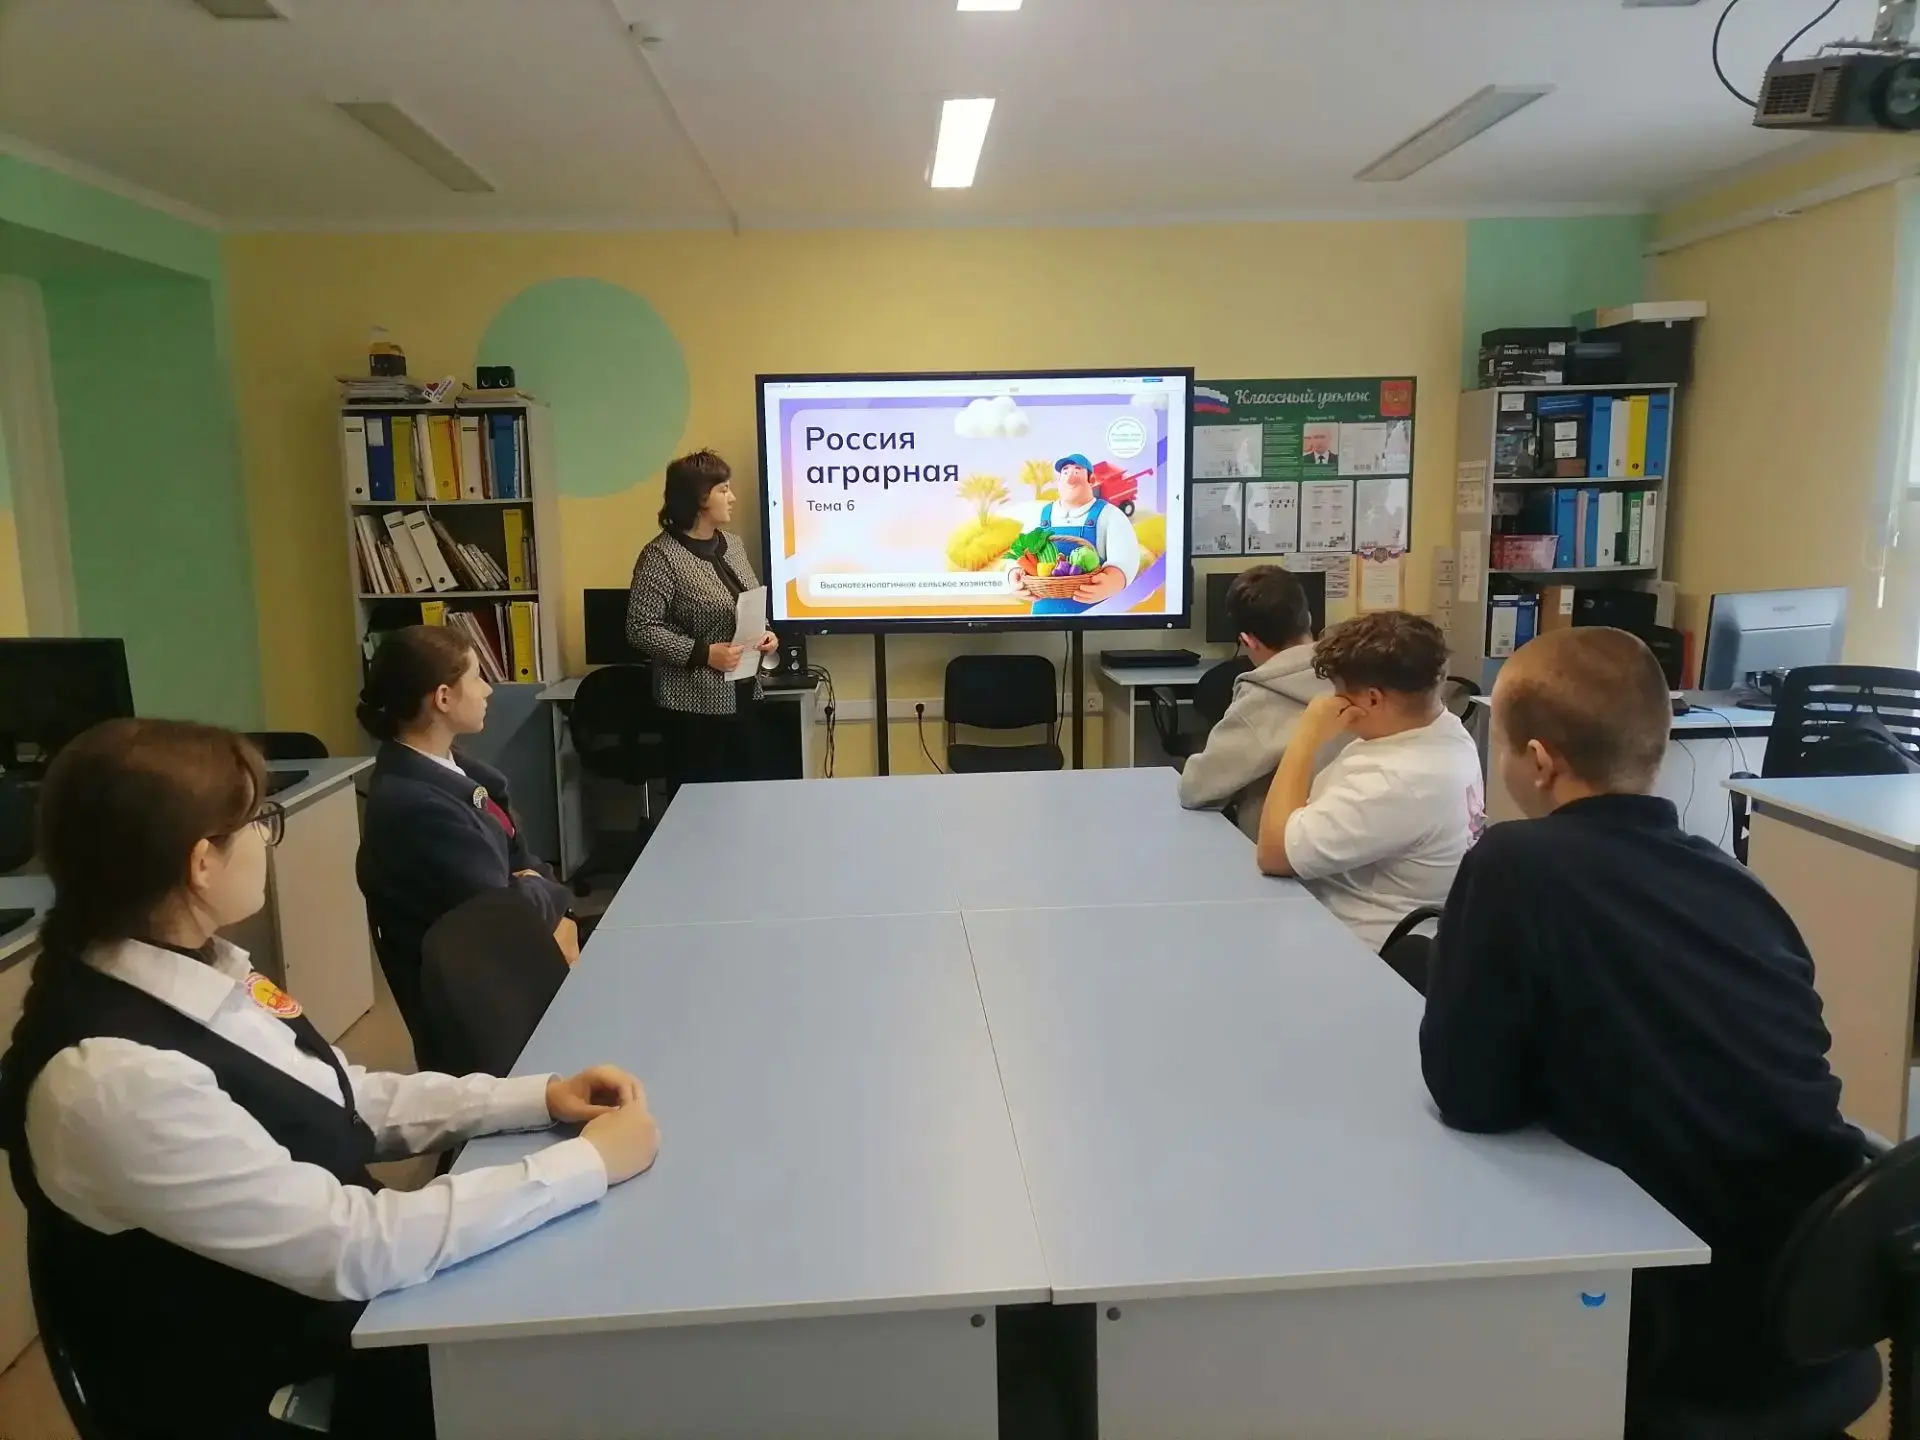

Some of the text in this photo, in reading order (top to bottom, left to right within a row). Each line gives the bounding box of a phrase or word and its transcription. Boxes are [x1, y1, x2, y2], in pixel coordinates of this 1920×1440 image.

[1234, 388, 1316, 405] Классный
[805, 426, 915, 451] Россия
[806, 464, 959, 490] аграрная
[806, 500, 855, 512] Тема 6
[820, 580, 916, 590] Высокотехнологичное
[918, 580, 958, 589] сельское
